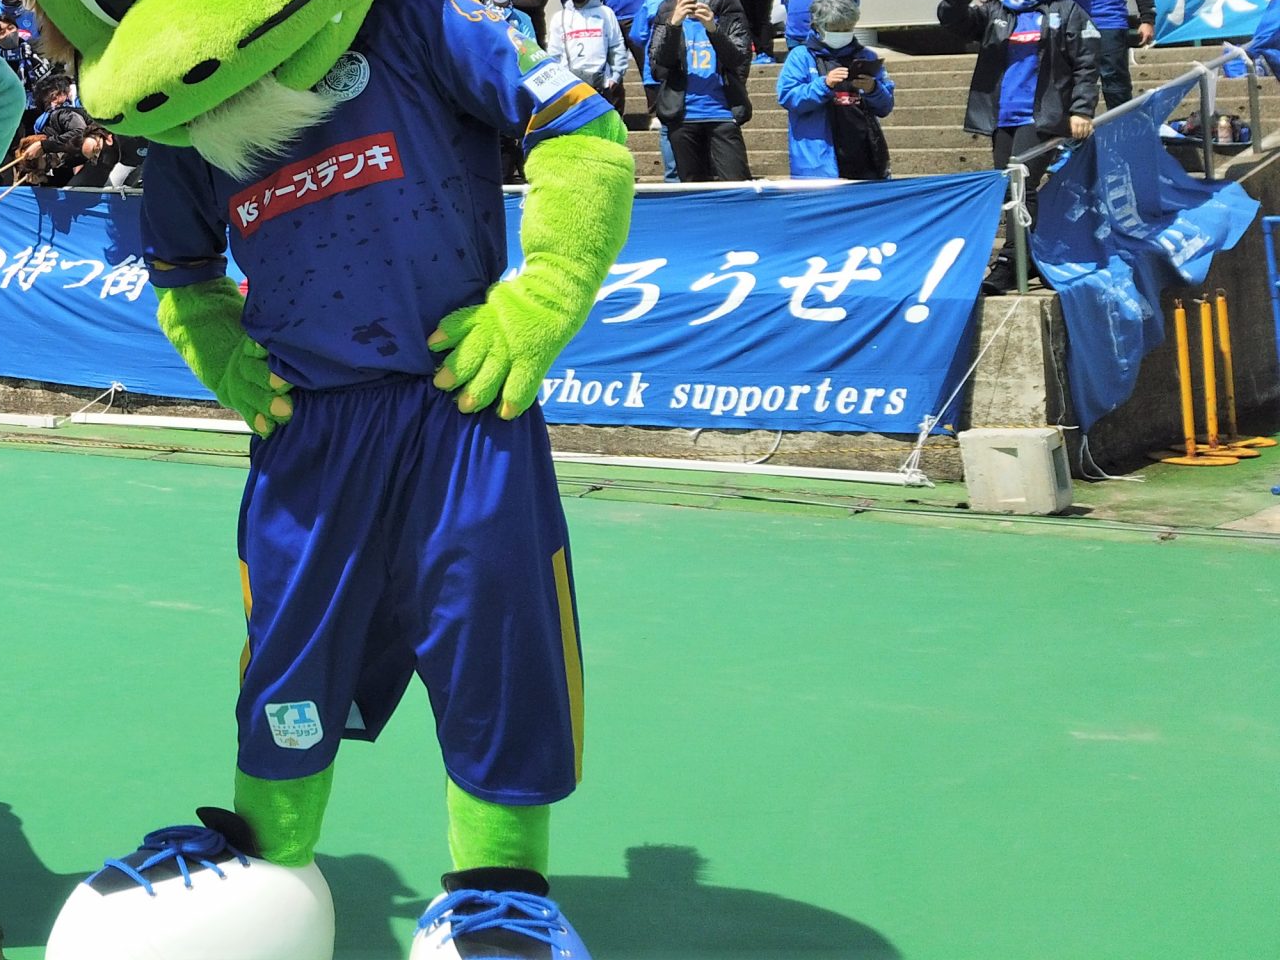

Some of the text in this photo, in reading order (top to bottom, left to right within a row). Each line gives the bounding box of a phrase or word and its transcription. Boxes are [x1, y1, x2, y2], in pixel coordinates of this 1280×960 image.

[692, 49, 711, 69] 12
[539, 368, 908, 417] yhock supporters
